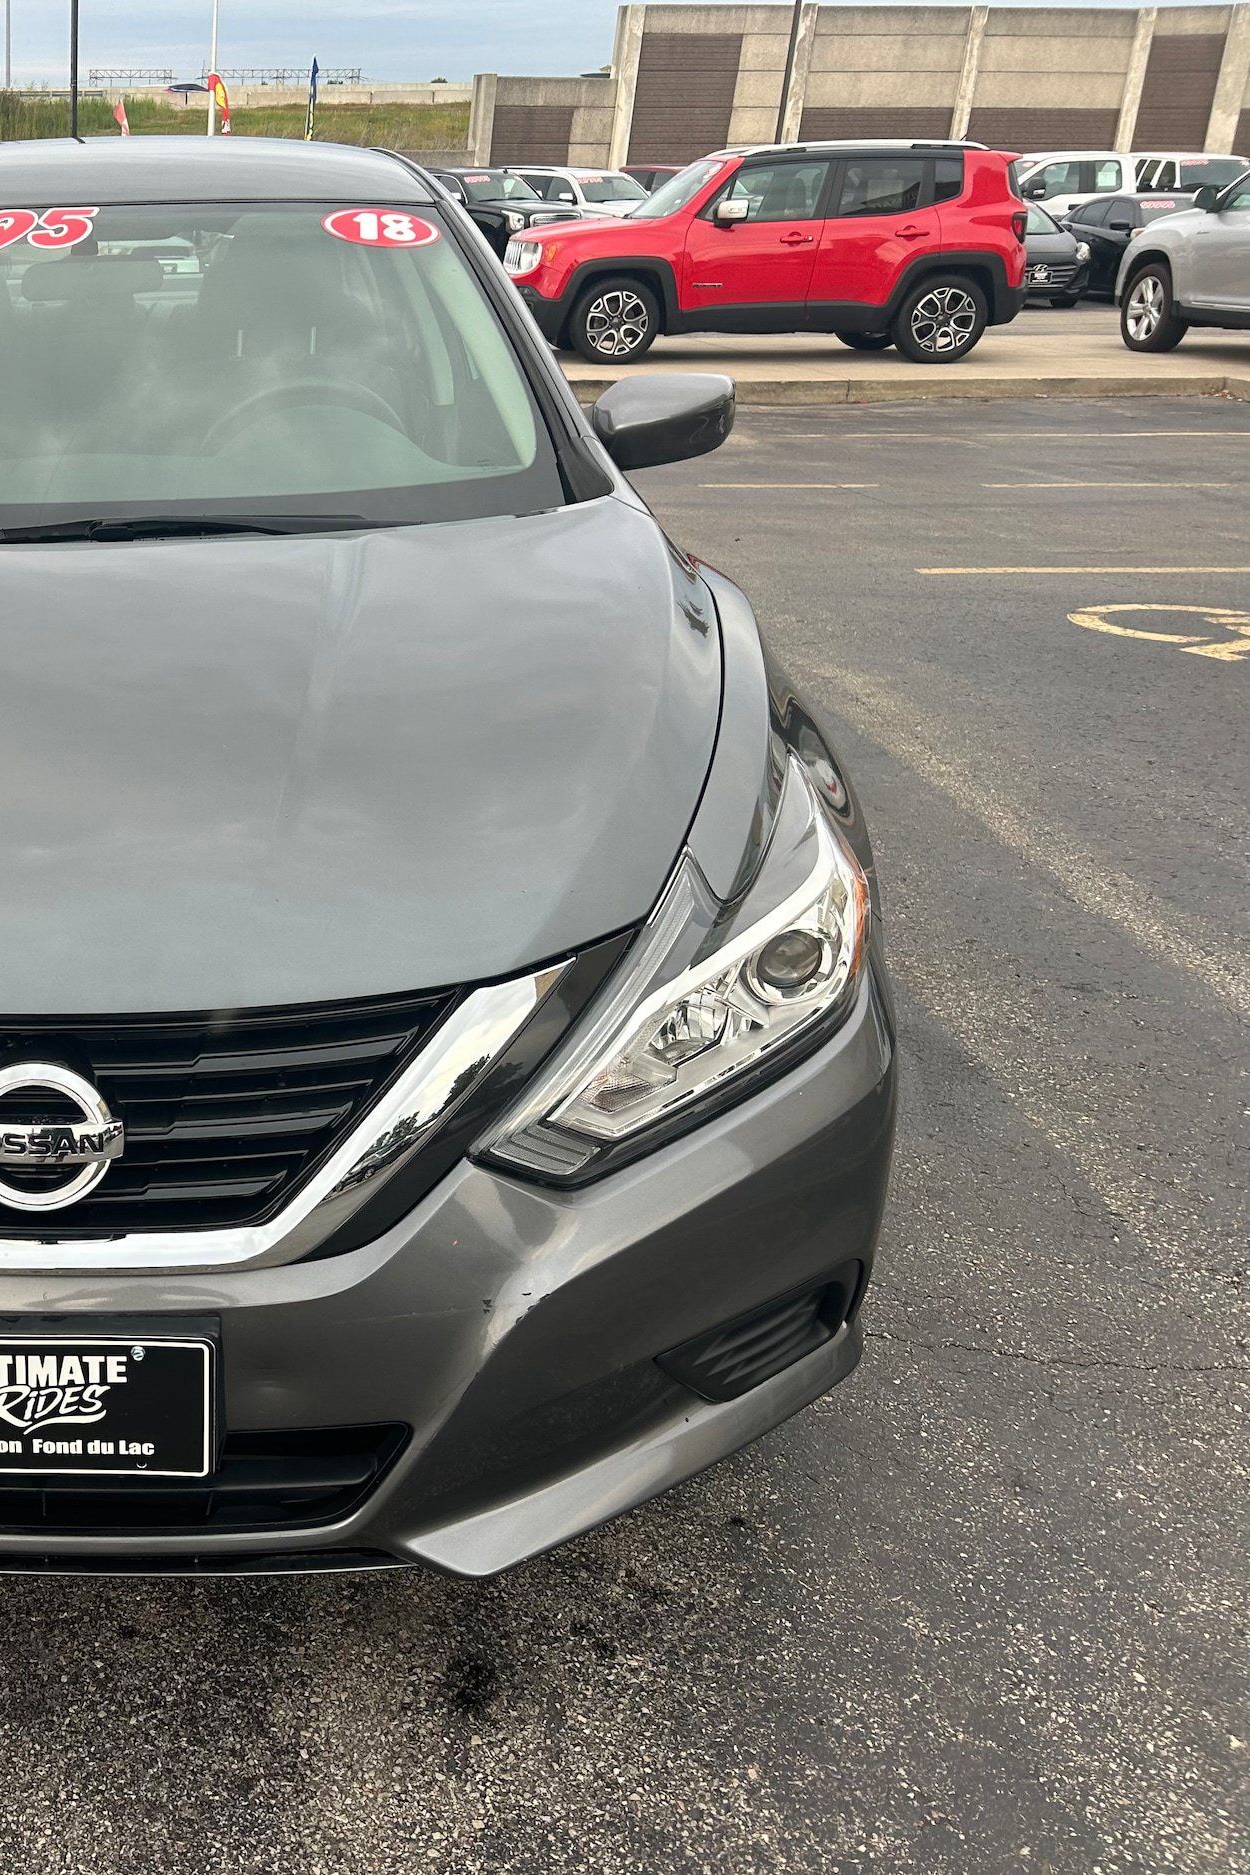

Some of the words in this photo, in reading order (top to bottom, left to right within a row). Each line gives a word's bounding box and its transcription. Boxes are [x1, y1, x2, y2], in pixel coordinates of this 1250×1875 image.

[352, 212, 416, 241] 18
[33, 1438, 82, 1455] Fond
[88, 1440, 114, 1455] du
[116, 1440, 155, 1456] Lac
